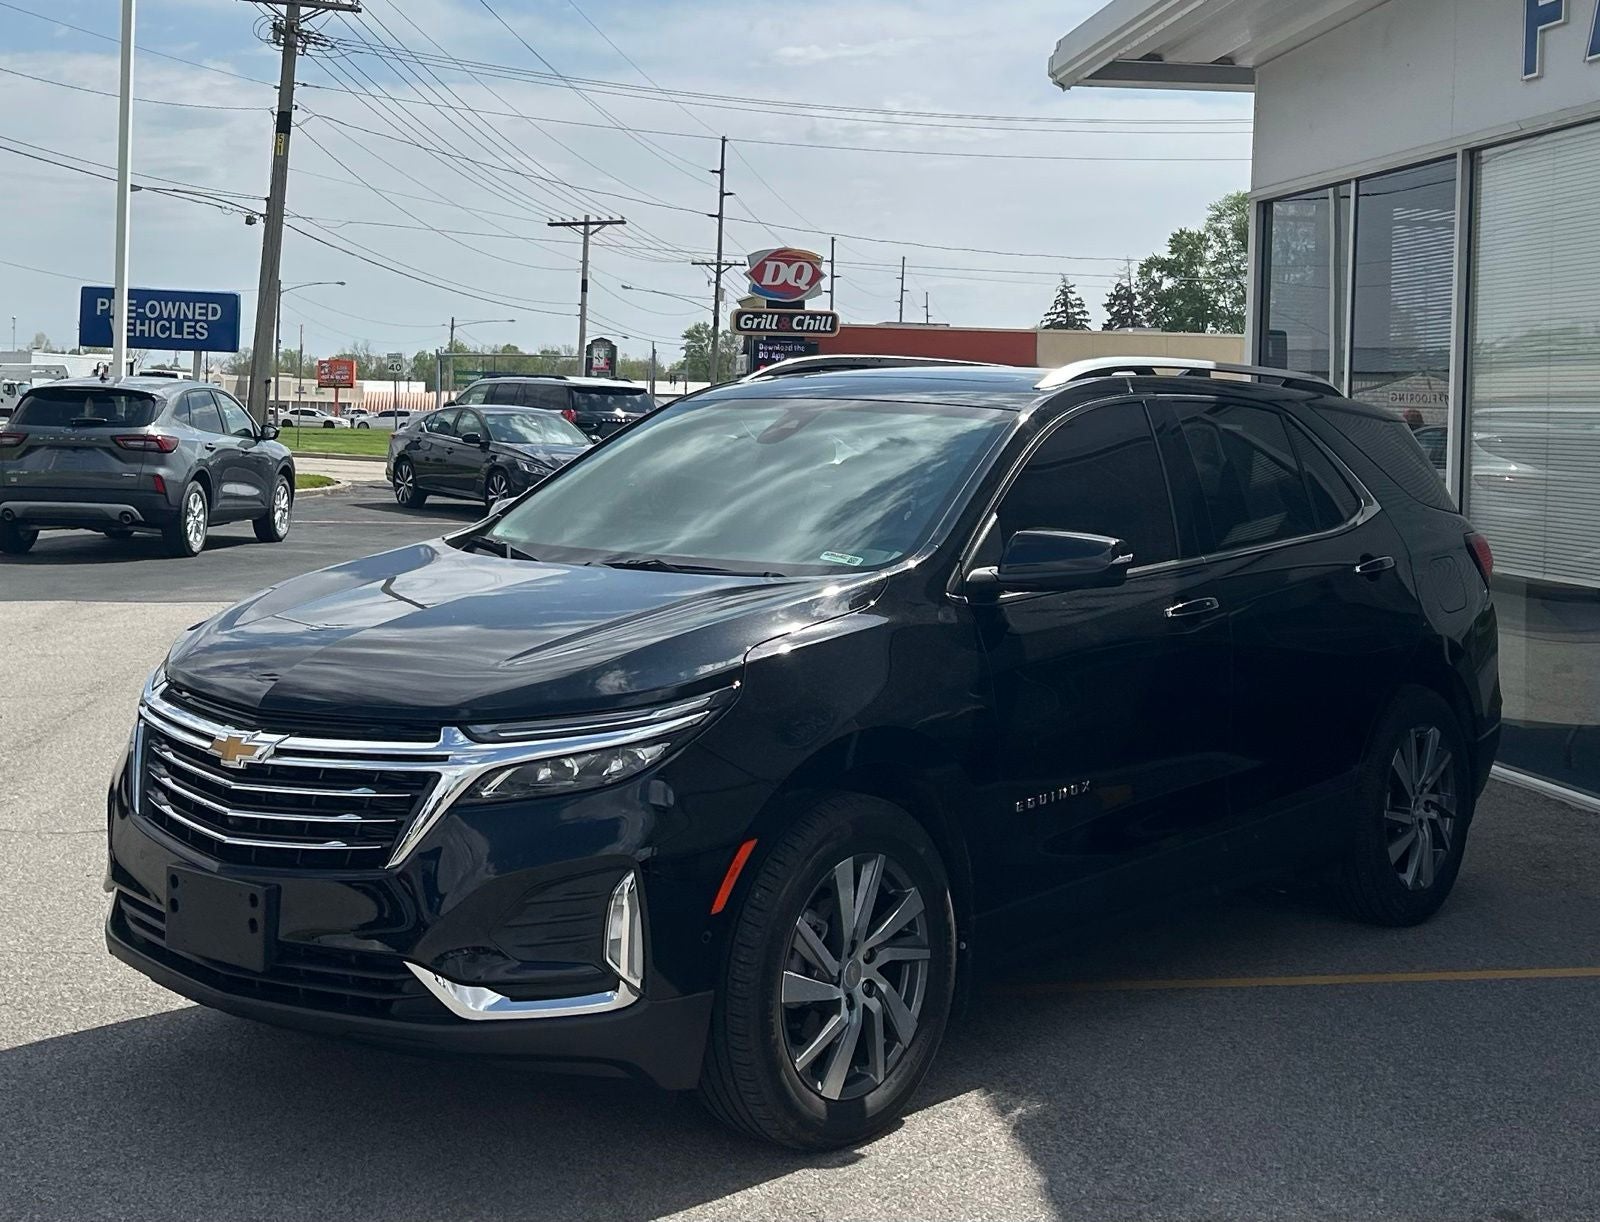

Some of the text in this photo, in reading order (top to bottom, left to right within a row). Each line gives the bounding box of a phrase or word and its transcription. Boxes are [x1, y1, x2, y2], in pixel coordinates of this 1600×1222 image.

[761, 260, 813, 290] DQ
[96, 298, 222, 321] PE-OWNED
[740, 314, 833, 331] Grill & Chill
[758, 343, 793, 351] Download
[758, 352, 785, 361] DQ App
[388, 363, 402, 372] 40
[1016, 780, 1090, 813] EQUINOX
